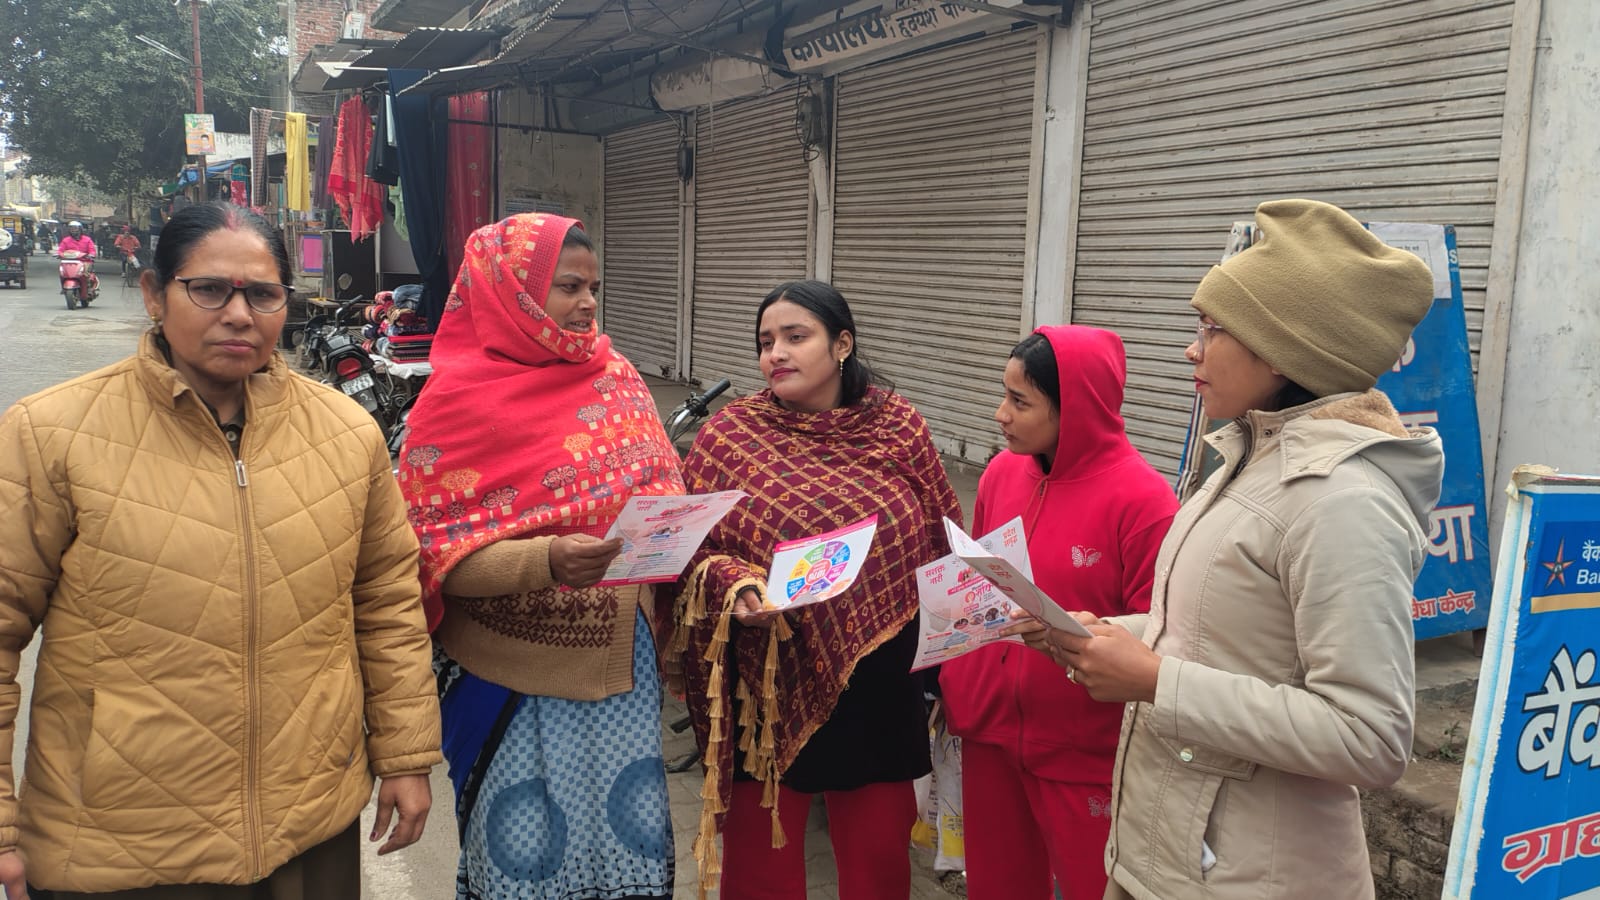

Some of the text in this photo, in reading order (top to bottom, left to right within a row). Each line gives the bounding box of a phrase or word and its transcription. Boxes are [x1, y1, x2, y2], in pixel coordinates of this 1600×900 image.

[790, 5, 887, 61] कार्यालय
[1576, 568, 1600, 585] Ba
[1439, 588, 1475, 614] केन्द्र
